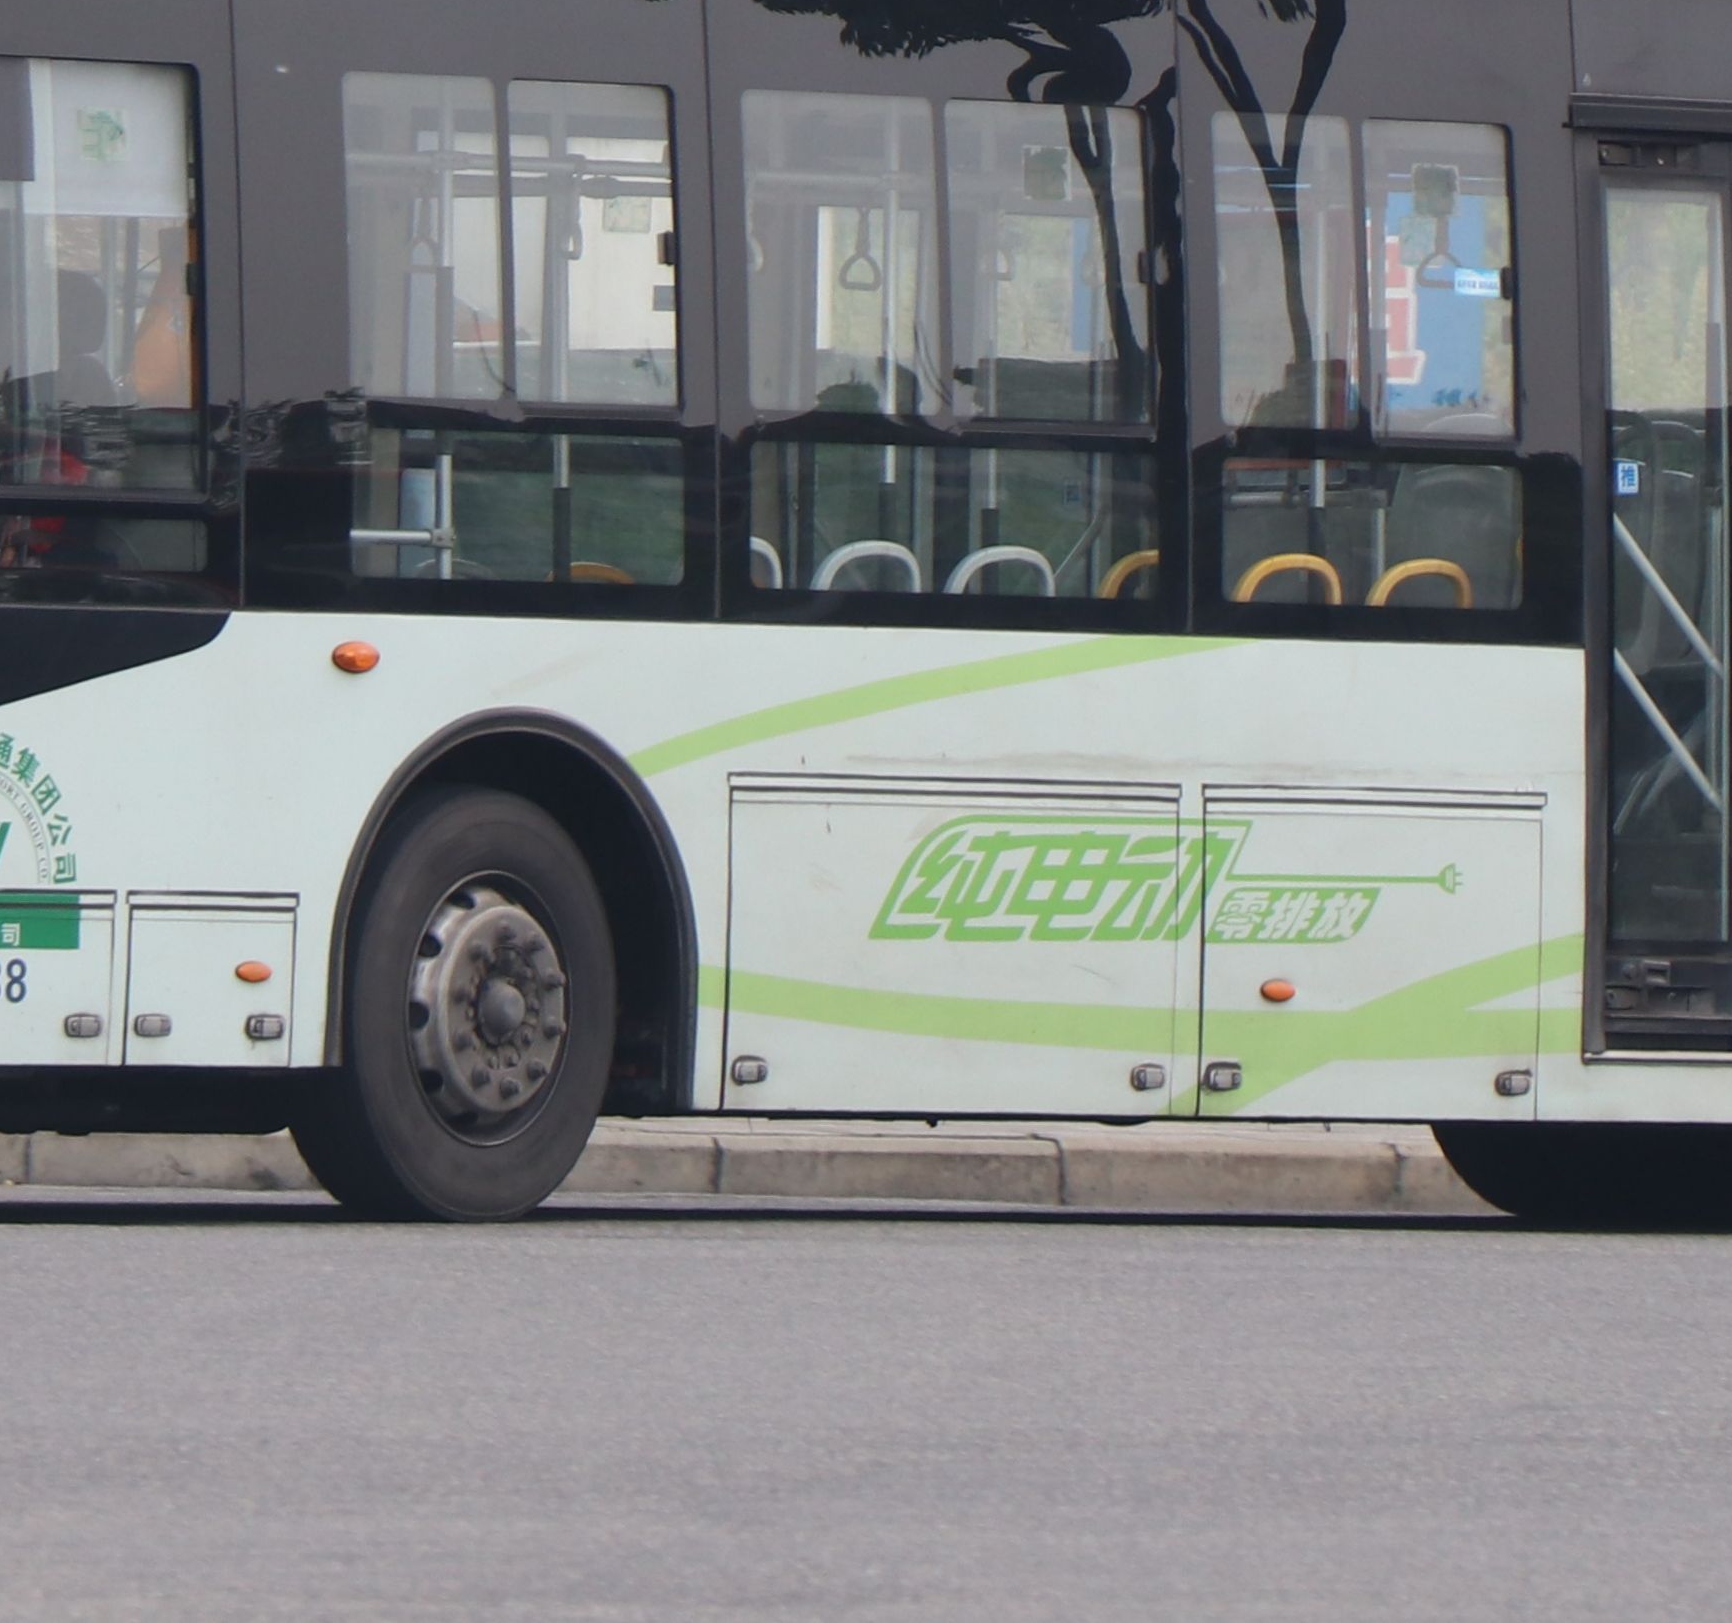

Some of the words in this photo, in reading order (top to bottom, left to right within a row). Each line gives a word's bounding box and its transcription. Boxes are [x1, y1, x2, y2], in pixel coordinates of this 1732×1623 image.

[873, 829, 1235, 942] 纯电动
[1214, 891, 1373, 941] 零排放
